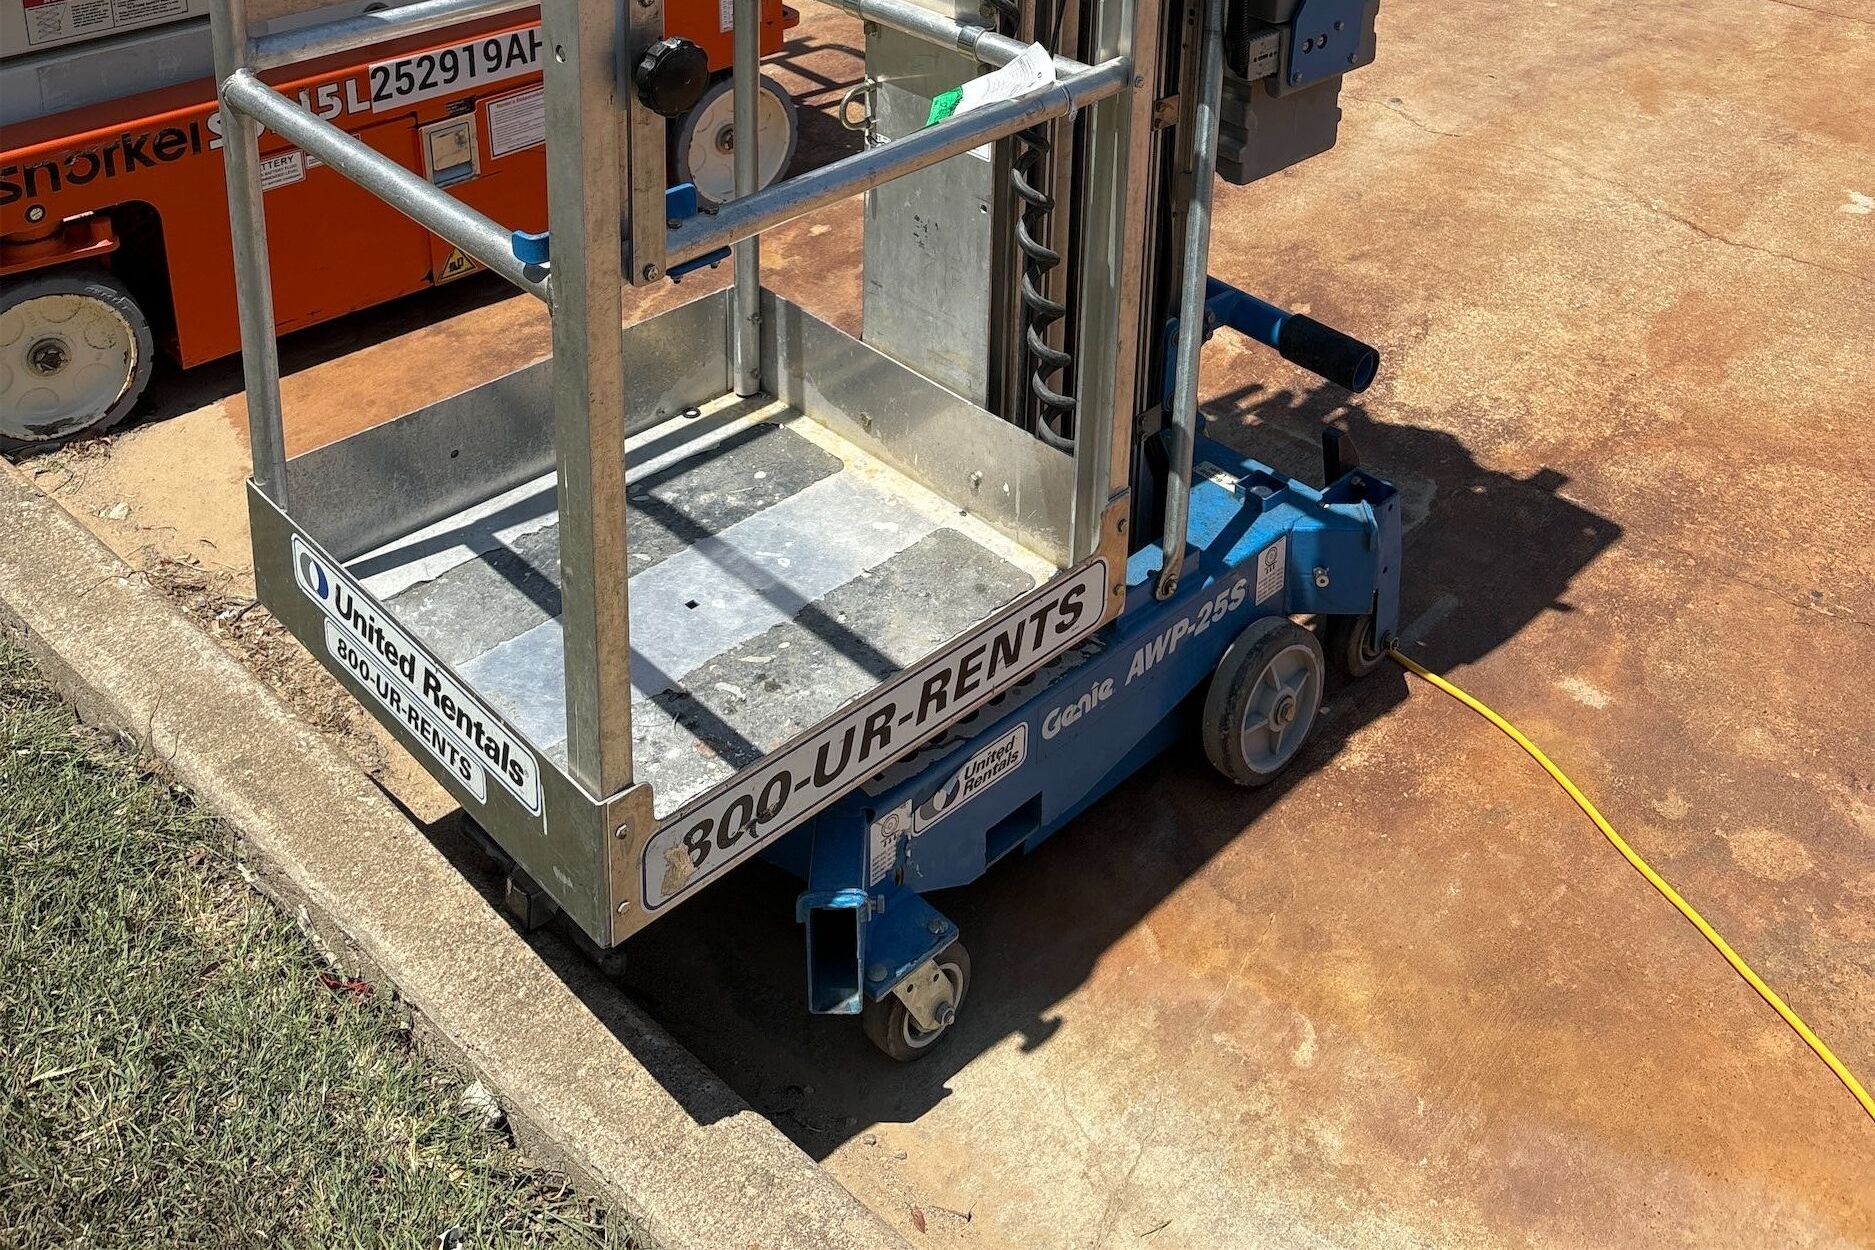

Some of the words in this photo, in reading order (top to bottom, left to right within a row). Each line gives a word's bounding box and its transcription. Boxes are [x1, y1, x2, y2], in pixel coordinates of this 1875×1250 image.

[0, 120, 201, 206] snorkel
[261, 155, 294, 170] TTERY
[334, 583, 416, 684] United
[422, 666, 525, 788] Rentals
[336, 637, 472, 783] 800-UR-RENTS
[1041, 677, 1115, 740] Genie
[1124, 578, 1248, 687] AWP-25S
[681, 582, 1087, 870] 800-UR-RENTS
[963, 750, 1019, 797] Rentals
[964, 735, 1015, 781] United
